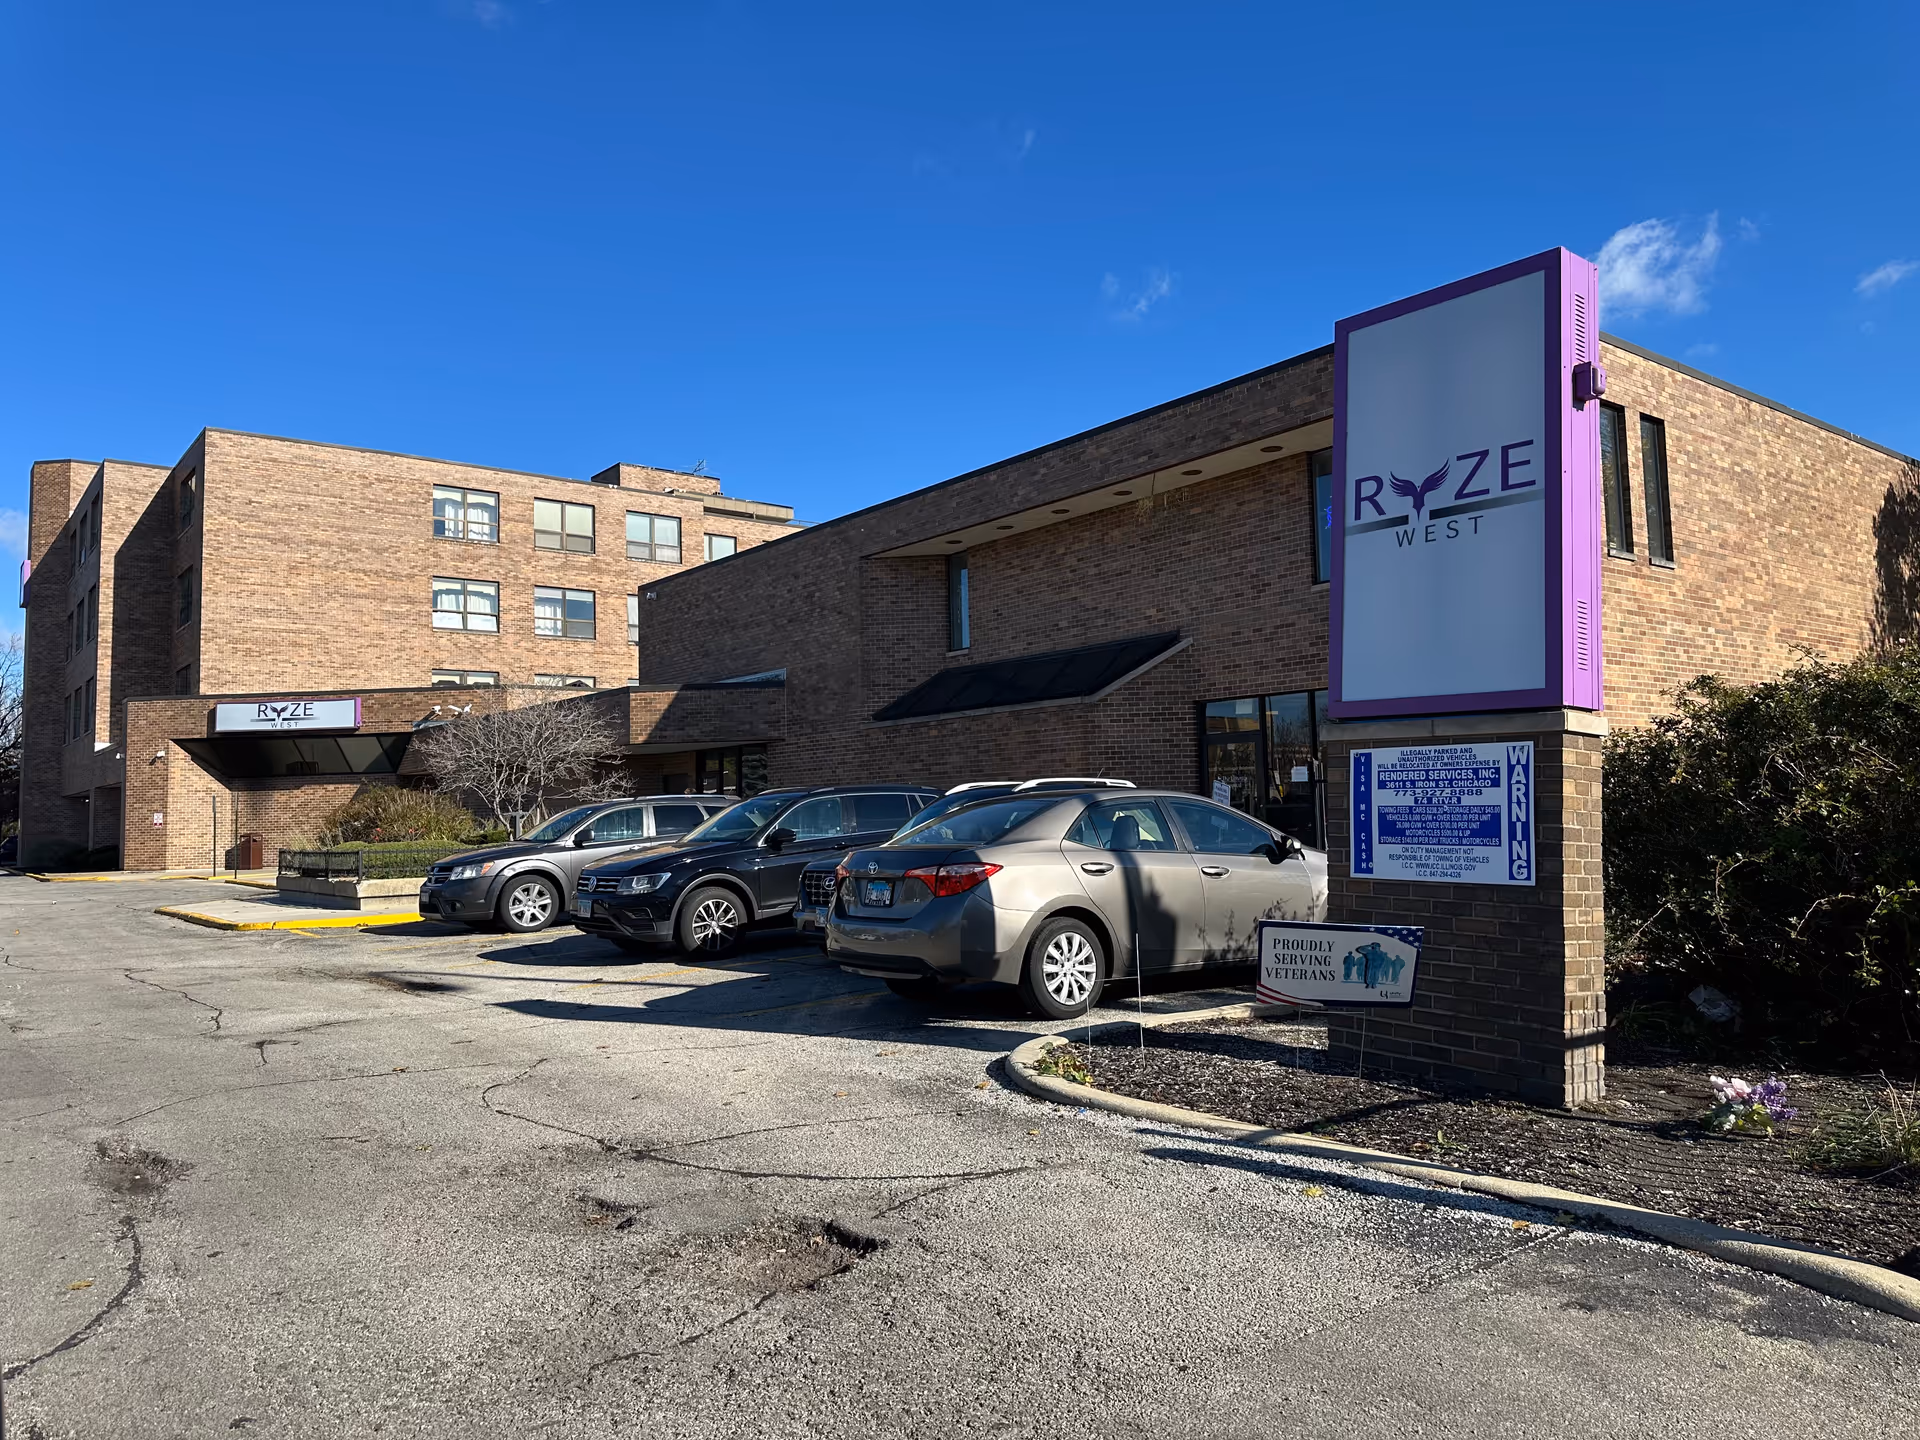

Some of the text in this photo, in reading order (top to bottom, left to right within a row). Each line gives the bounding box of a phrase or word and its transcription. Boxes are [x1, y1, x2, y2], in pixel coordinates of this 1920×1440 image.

[1396, 515, 1484, 547] WEST
[1398, 754, 1444, 762] UNAUTHORIZED
[1380, 768, 1498, 780] RENDERED SERVICES, INC.
[1393, 788, 1483, 796] 773-927-8888
[1508, 746, 1528, 880] WARNING
[1273, 938, 1335, 952] PROUDLY
[1274, 953, 1331, 967] SERVING
[1265, 967, 1336, 982] VETERANS
